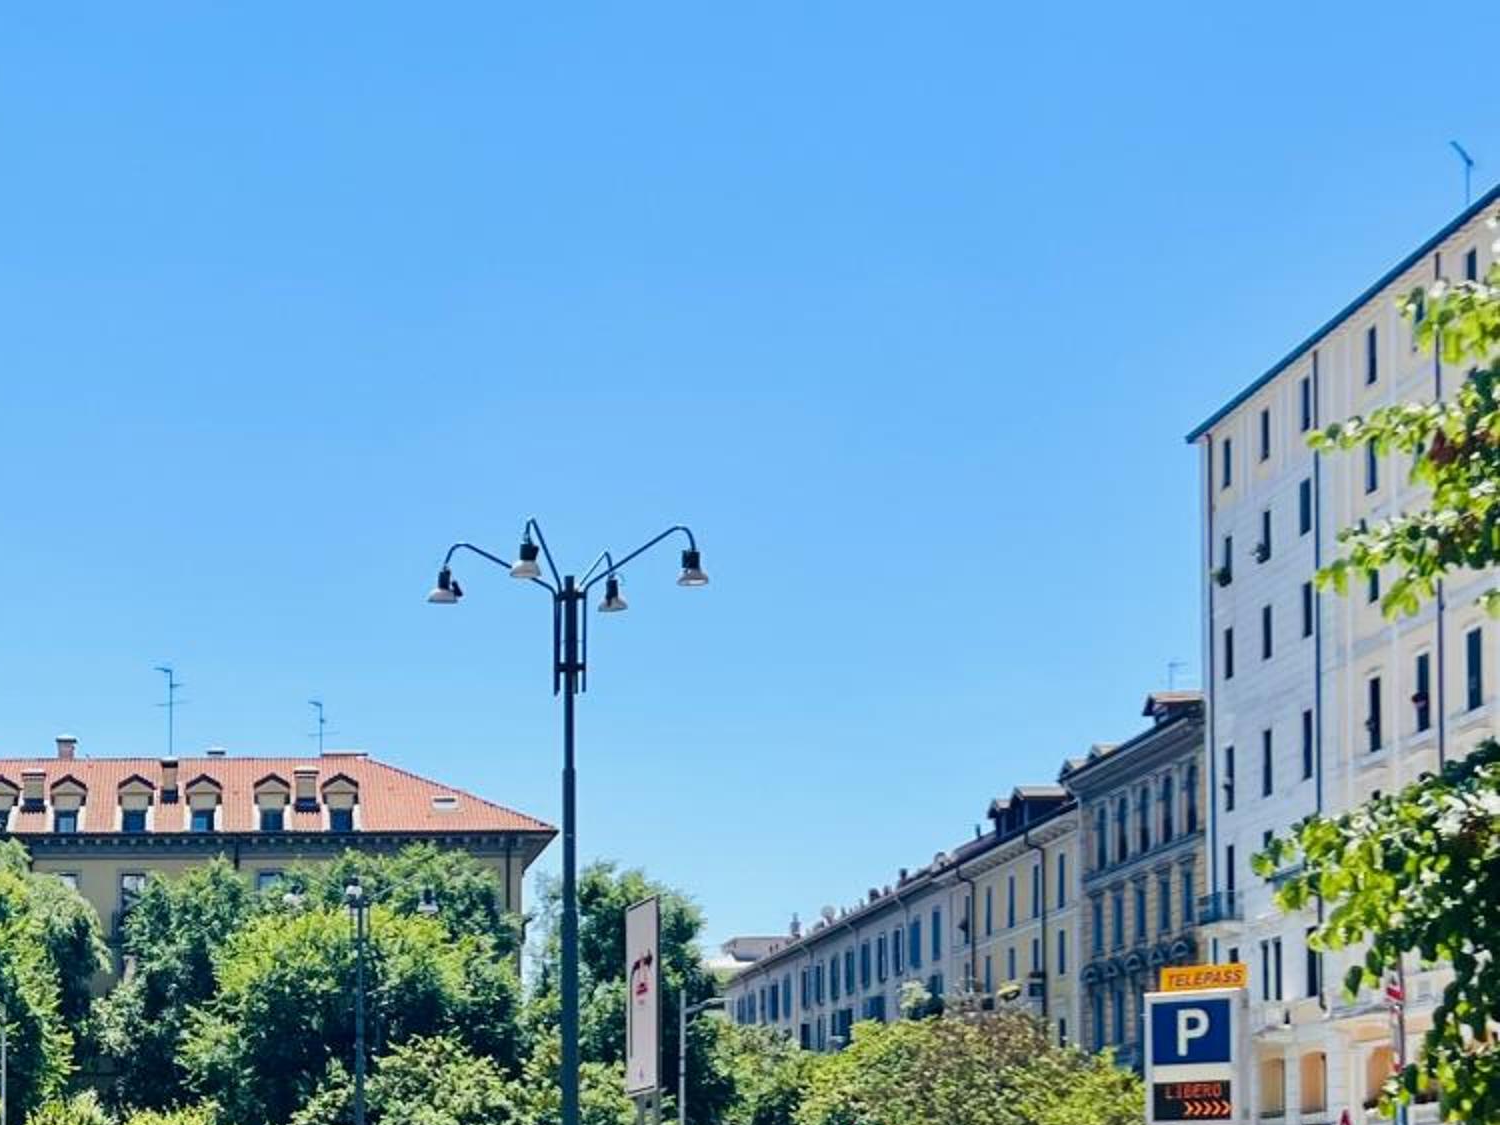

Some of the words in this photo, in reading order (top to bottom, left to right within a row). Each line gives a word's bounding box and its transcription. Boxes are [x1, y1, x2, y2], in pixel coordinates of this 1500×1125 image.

[1168, 970, 1241, 987] TELEPASS
[1177, 1008, 1209, 1056] P
[1165, 1082, 1221, 1099] LIBERO
